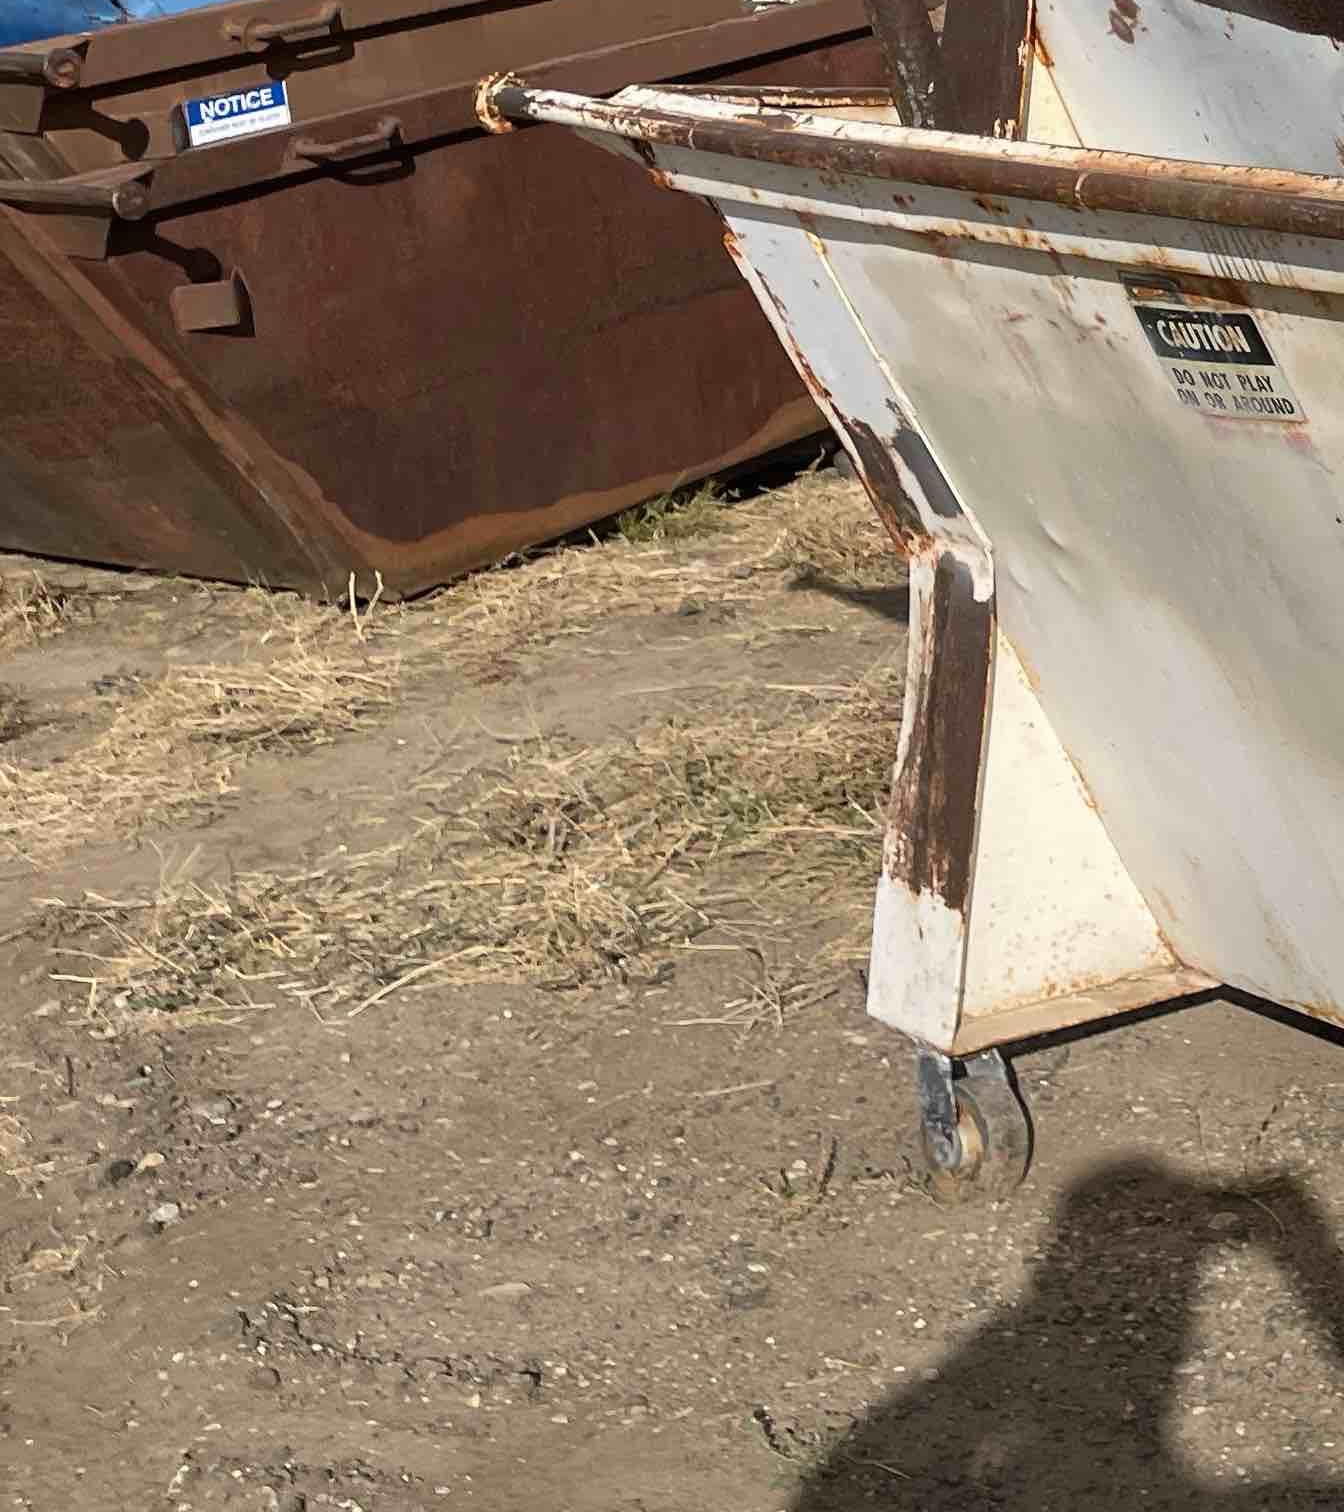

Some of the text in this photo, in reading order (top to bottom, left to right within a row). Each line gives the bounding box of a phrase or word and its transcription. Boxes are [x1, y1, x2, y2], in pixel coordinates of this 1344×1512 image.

[199, 87, 274, 122] NOTICE
[1156, 319, 1252, 354] CAUTION
[1172, 367, 1275, 393] DO NOT PLAY
[1177, 388, 1296, 416] ON OR AROUND
